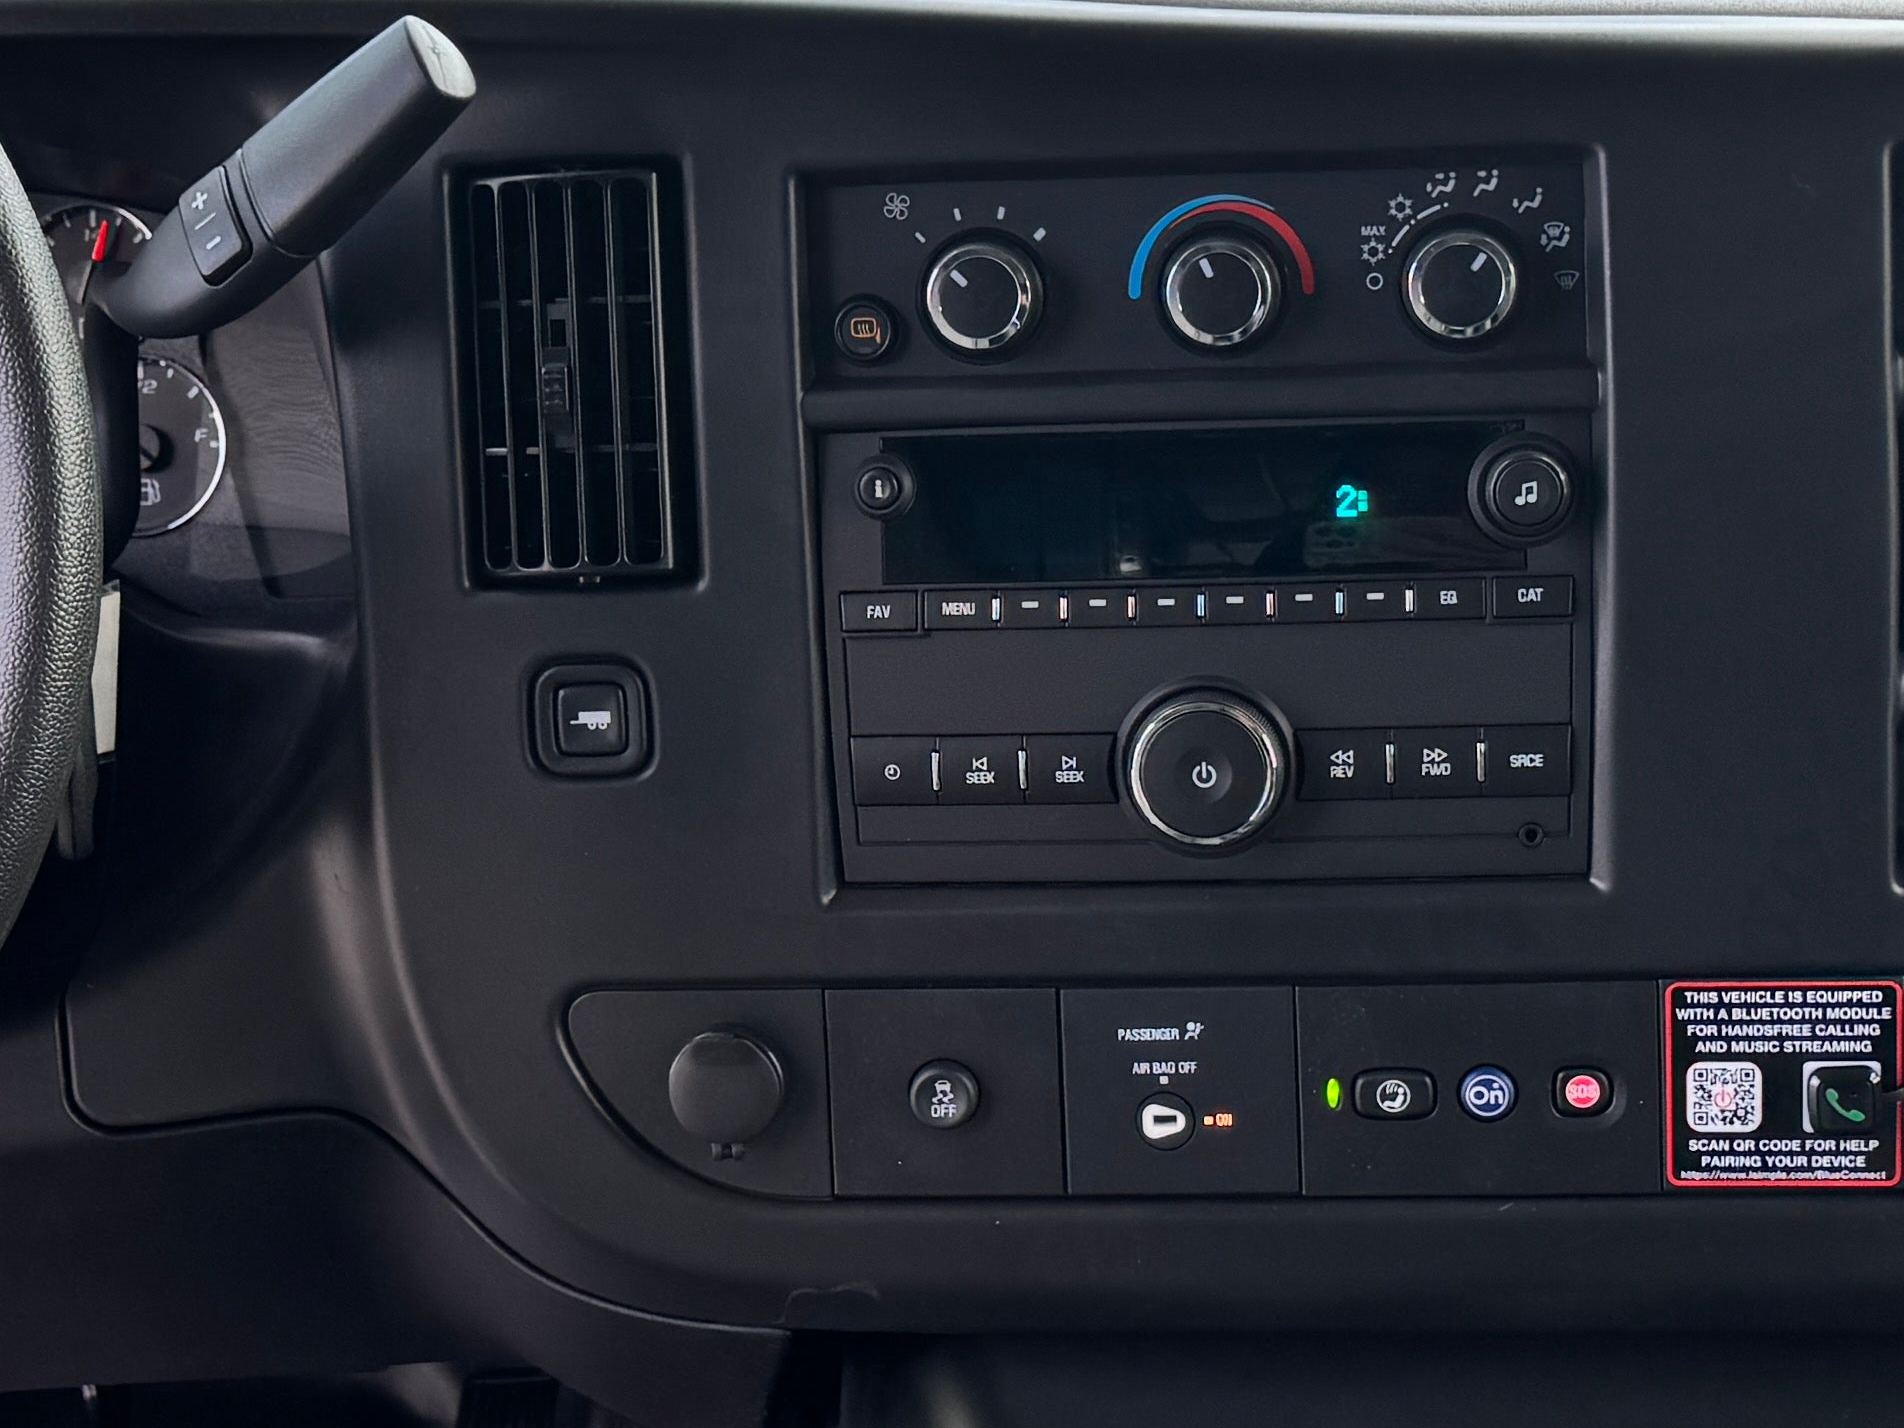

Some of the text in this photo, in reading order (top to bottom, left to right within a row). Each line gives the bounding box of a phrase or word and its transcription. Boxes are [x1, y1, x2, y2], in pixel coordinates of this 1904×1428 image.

[1360, 225, 1386, 236] MAX
[194, 427, 208, 443] F
[1439, 590, 1458, 605] EQ
[1517, 587, 1544, 603] CAT
[866, 605, 891, 619] FAV
[941, 602, 976, 616] MENU
[1509, 753, 1544, 768] SRCE
[1329, 765, 1355, 778] REV
[1421, 762, 1451, 776] FWD
[965, 771, 995, 784] SEEK
[1055, 770, 1085, 783] SEEK
[1684, 990, 1884, 1004] THIS VEHICLE IS EQUIPPED
[1675, 1007, 1892, 1021] WITH A BLUETOOTH MODULE
[1117, 1028, 1180, 1041] PASSENGER
[1687, 1023, 1881, 1037] FOR HANDSFREE CALLING
[1695, 1040, 1873, 1053] AND MUSIC STREAMING
[1132, 1061, 1197, 1074] AIR BAG OFF
[1567, 1083, 1597, 1099] SOS
[930, 1103, 957, 1118] OFF
[1688, 1139, 1880, 1151] SCAN QR CODE FOR HELP
[1701, 1156, 1866, 1168] PAIRING YOUR DEVICE
